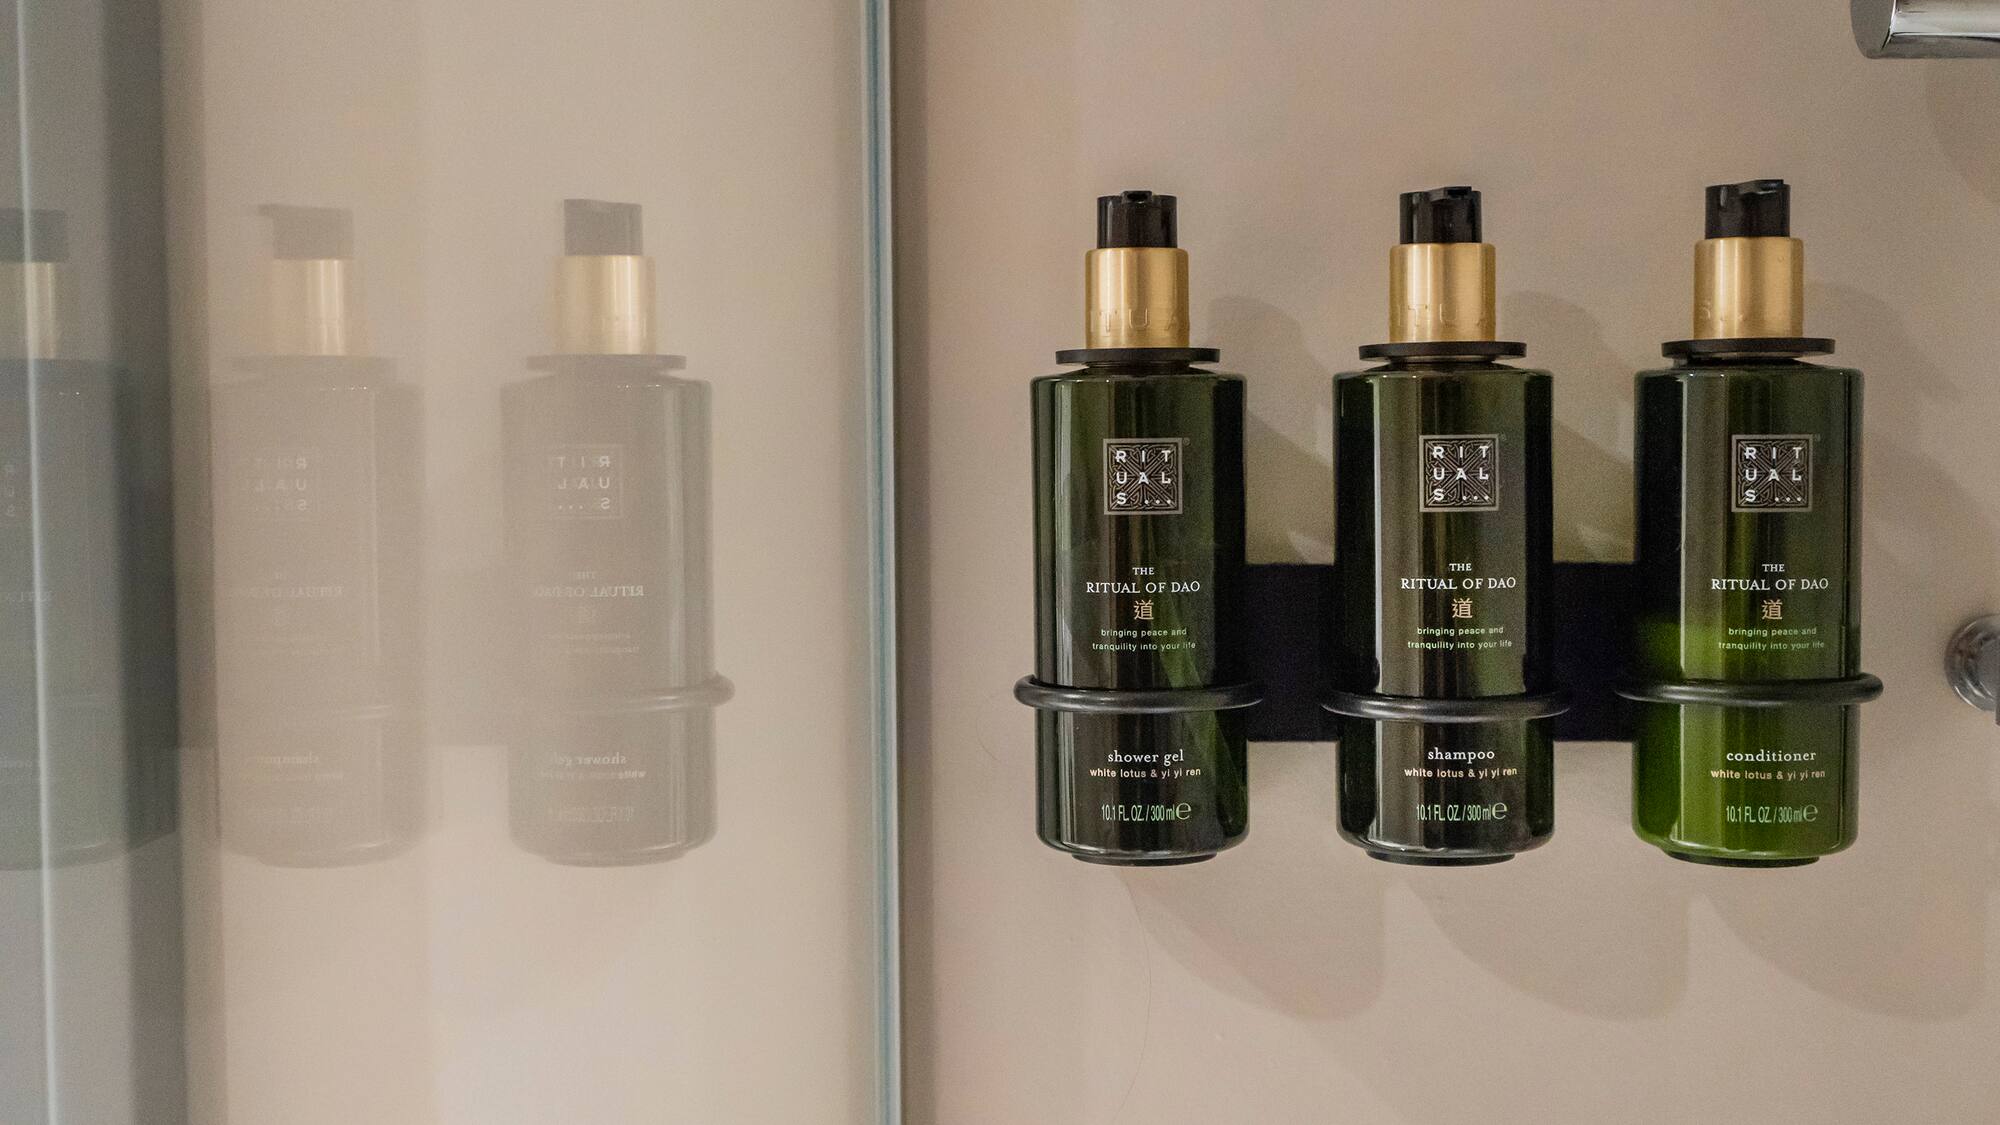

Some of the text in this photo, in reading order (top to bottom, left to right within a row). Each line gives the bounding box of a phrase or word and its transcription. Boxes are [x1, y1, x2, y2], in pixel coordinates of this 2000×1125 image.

[1133, 567, 1154, 575] THE
[1449, 563, 1472, 571] THE
[1762, 564, 1785, 572] THE
[1086, 581, 1200, 593] RITUAL OF DAO
[1401, 577, 1516, 590] RITUAL OF DAO
[1711, 578, 1829, 590] RITUAL OF DAO
[1134, 599, 1154, 620] 道
[1452, 598, 1473, 618] 道
[1762, 599, 1782, 620] 道
[1101, 629, 1137, 637] bringing
[1141, 629, 1168, 637] peace
[1417, 627, 1454, 636] bringing
[1458, 627, 1485, 636] peace
[1728, 627, 1817, 637] bringing peace and
[1093, 642, 1137, 651] tranquility
[1183, 641, 1196, 649] life
[1408, 641, 1454, 650] tranquility
[1719, 642, 1766, 651] tranquility
[1791, 642, 1809, 650] your
[1108, 749, 1184, 766] shower gel
[1428, 747, 1495, 763] shampoo
[1727, 749, 1816, 762] conditioner
[1089, 768, 1200, 779] white lotus & yi yi ren
[1404, 768, 1517, 779] white lotus & yi yi ren
[1711, 770, 1825, 781] white lotus & yi yi ren
[1102, 804, 1116, 820] 10.1
[1416, 804, 1431, 820] 10.1
[1726, 805, 1741, 822] 10.1
